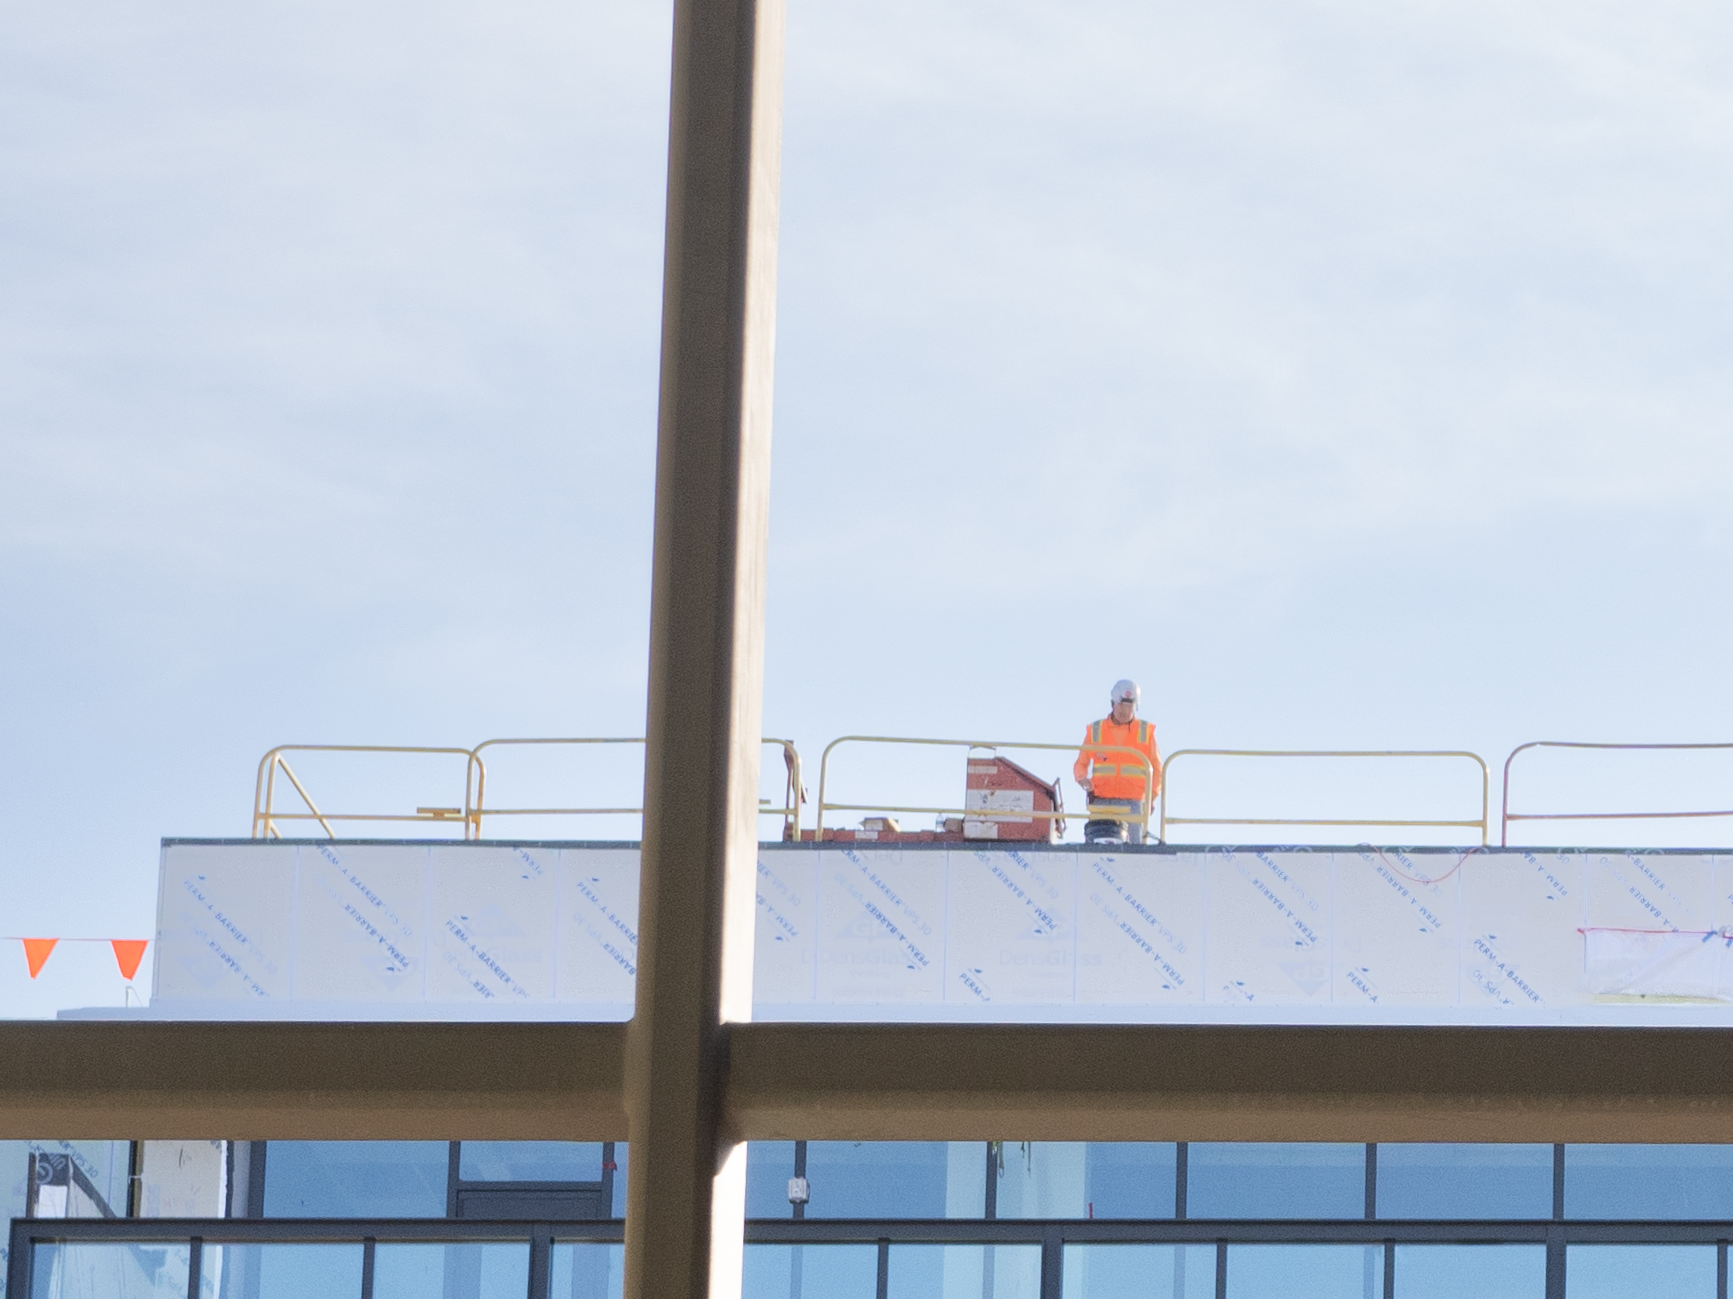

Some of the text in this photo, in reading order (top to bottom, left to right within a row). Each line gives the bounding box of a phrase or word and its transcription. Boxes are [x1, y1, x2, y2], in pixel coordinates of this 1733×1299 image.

[575, 880, 638, 945] PERM-A-BARRIE
[1092, 861, 1159, 927] PERM-A-BARRIER
[1252, 875, 1318, 943] PERM-A-BARRIER
[864, 900, 931, 968] PERM-A-BARRIER
[1119, 920, 1186, 988] PERM-A-BARRIER
